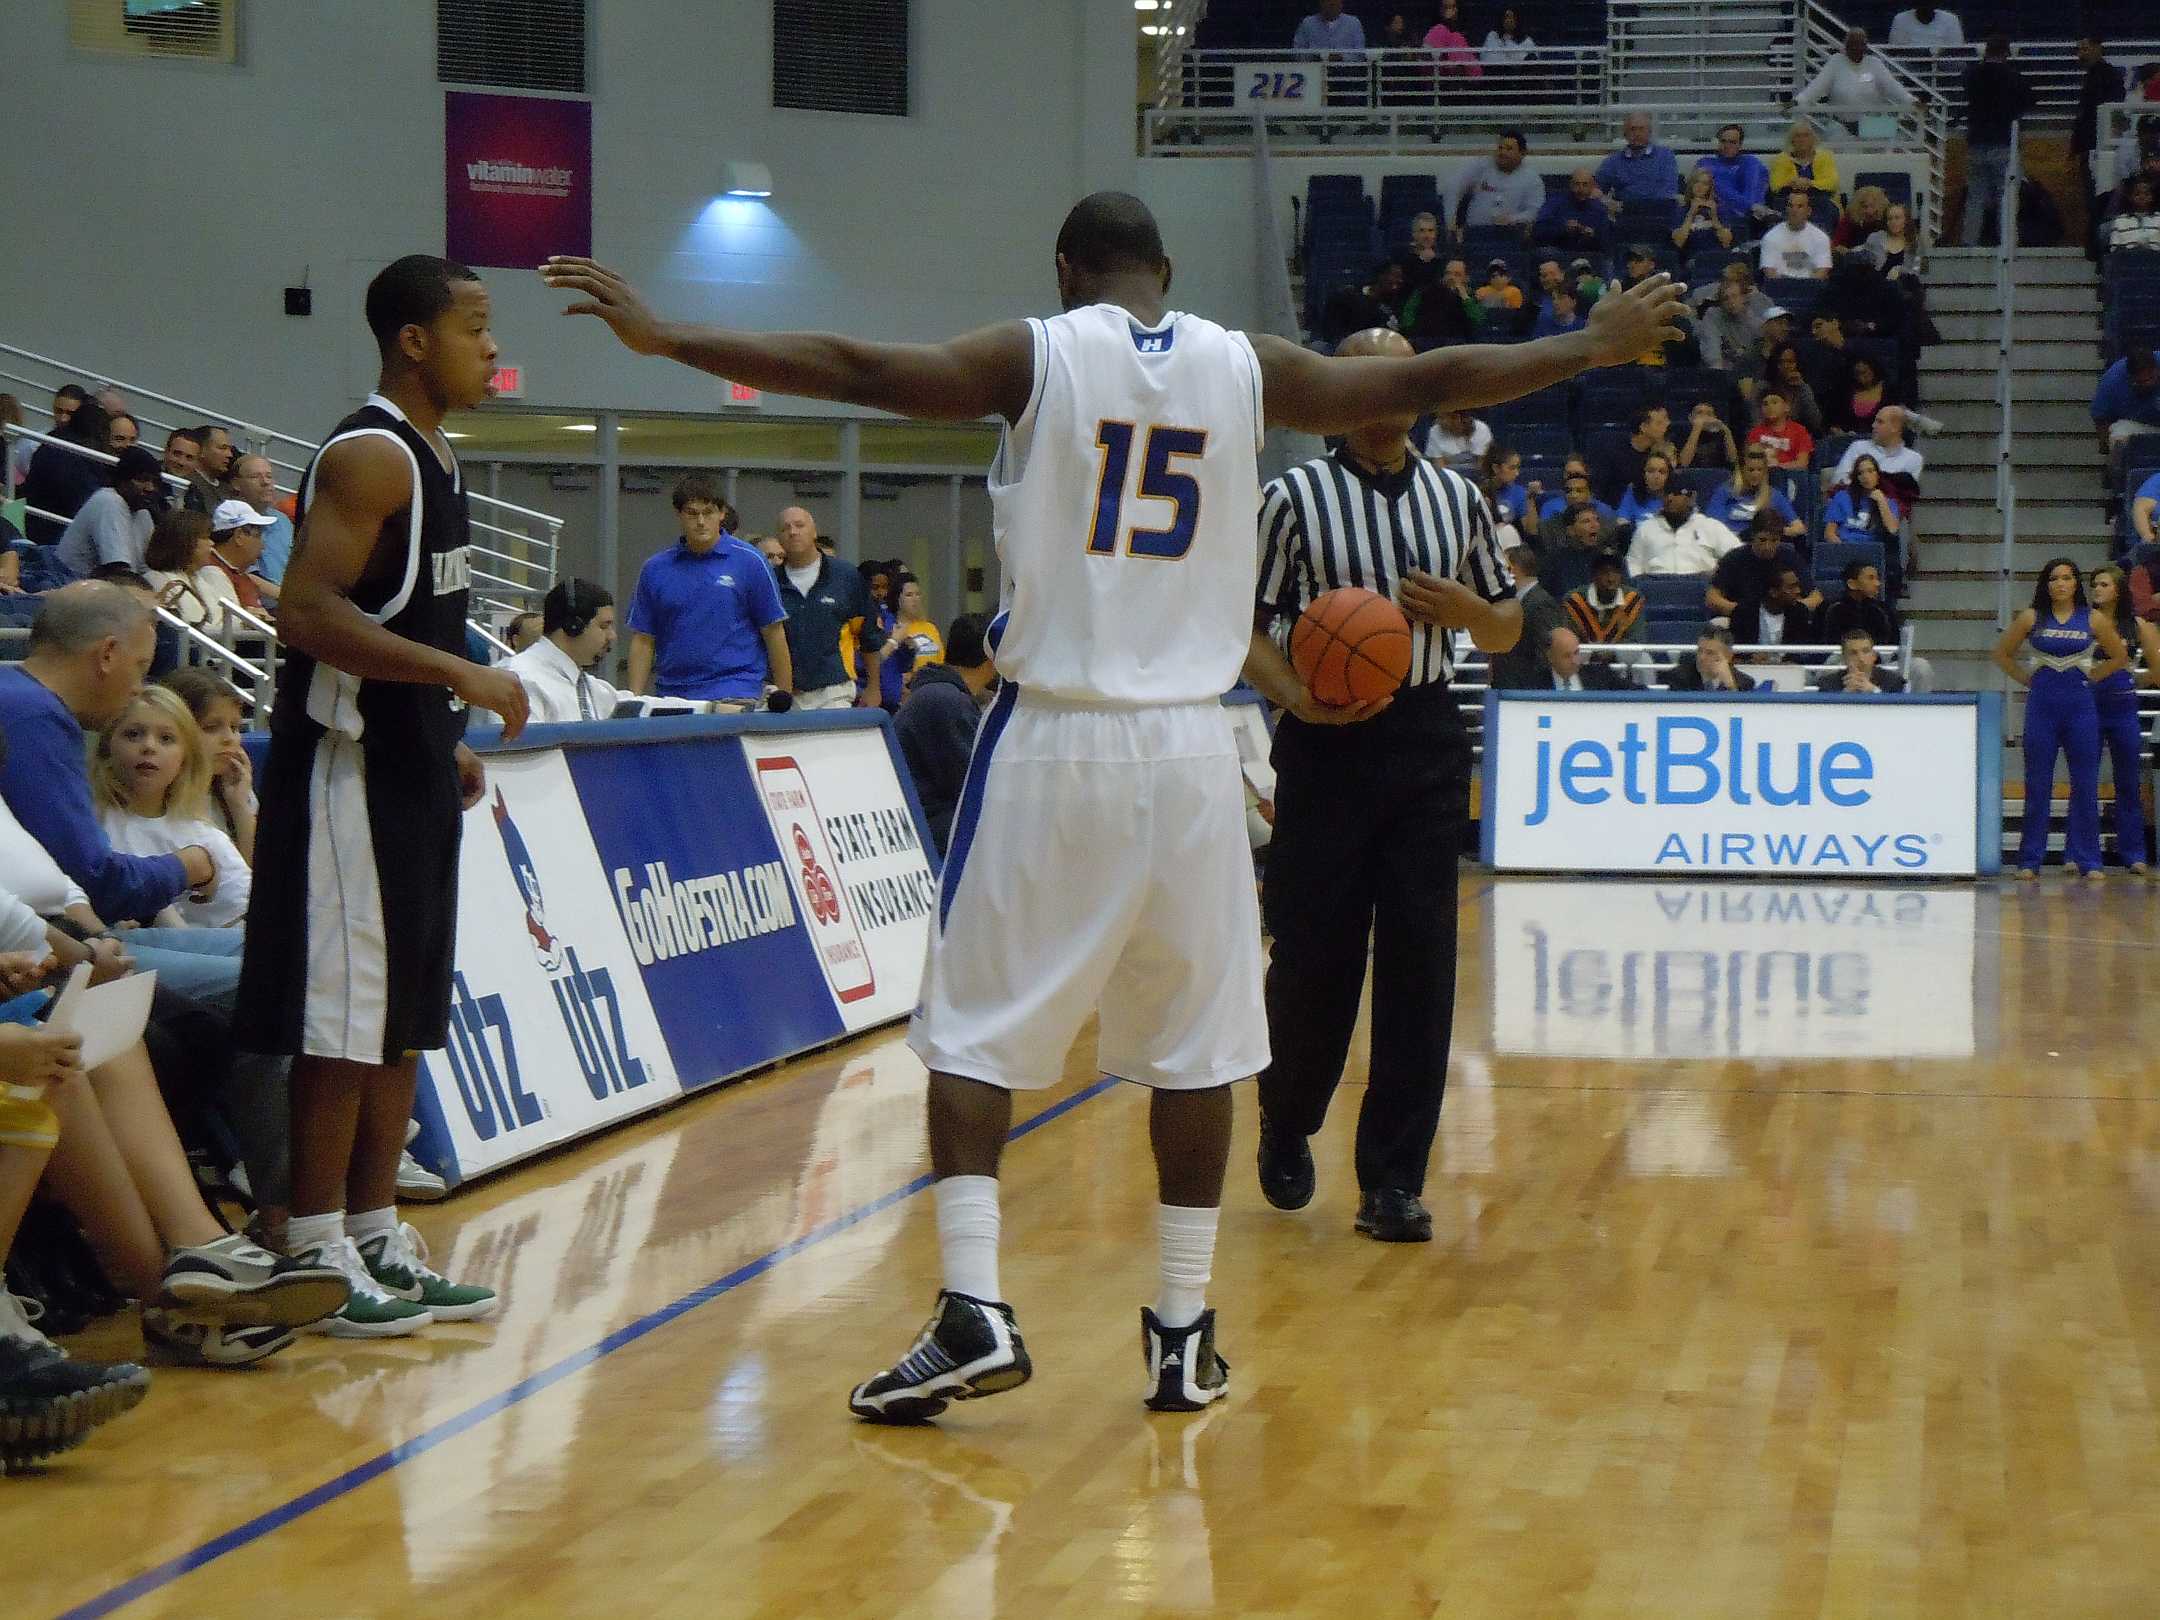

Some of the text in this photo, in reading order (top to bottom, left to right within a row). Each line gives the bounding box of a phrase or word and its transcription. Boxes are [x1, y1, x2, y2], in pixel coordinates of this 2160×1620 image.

[1249, 73, 1305, 98] 212
[467, 160, 573, 186] vitaminwater
[1141, 338, 1163, 351] H
[1087, 419, 1208, 561] 15
[1524, 716, 1874, 826] jetBlue
[826, 807, 919, 864] STATE FARM
[1654, 832, 1930, 868] AIRWAYS
[850, 869, 936, 932] INSURANC
